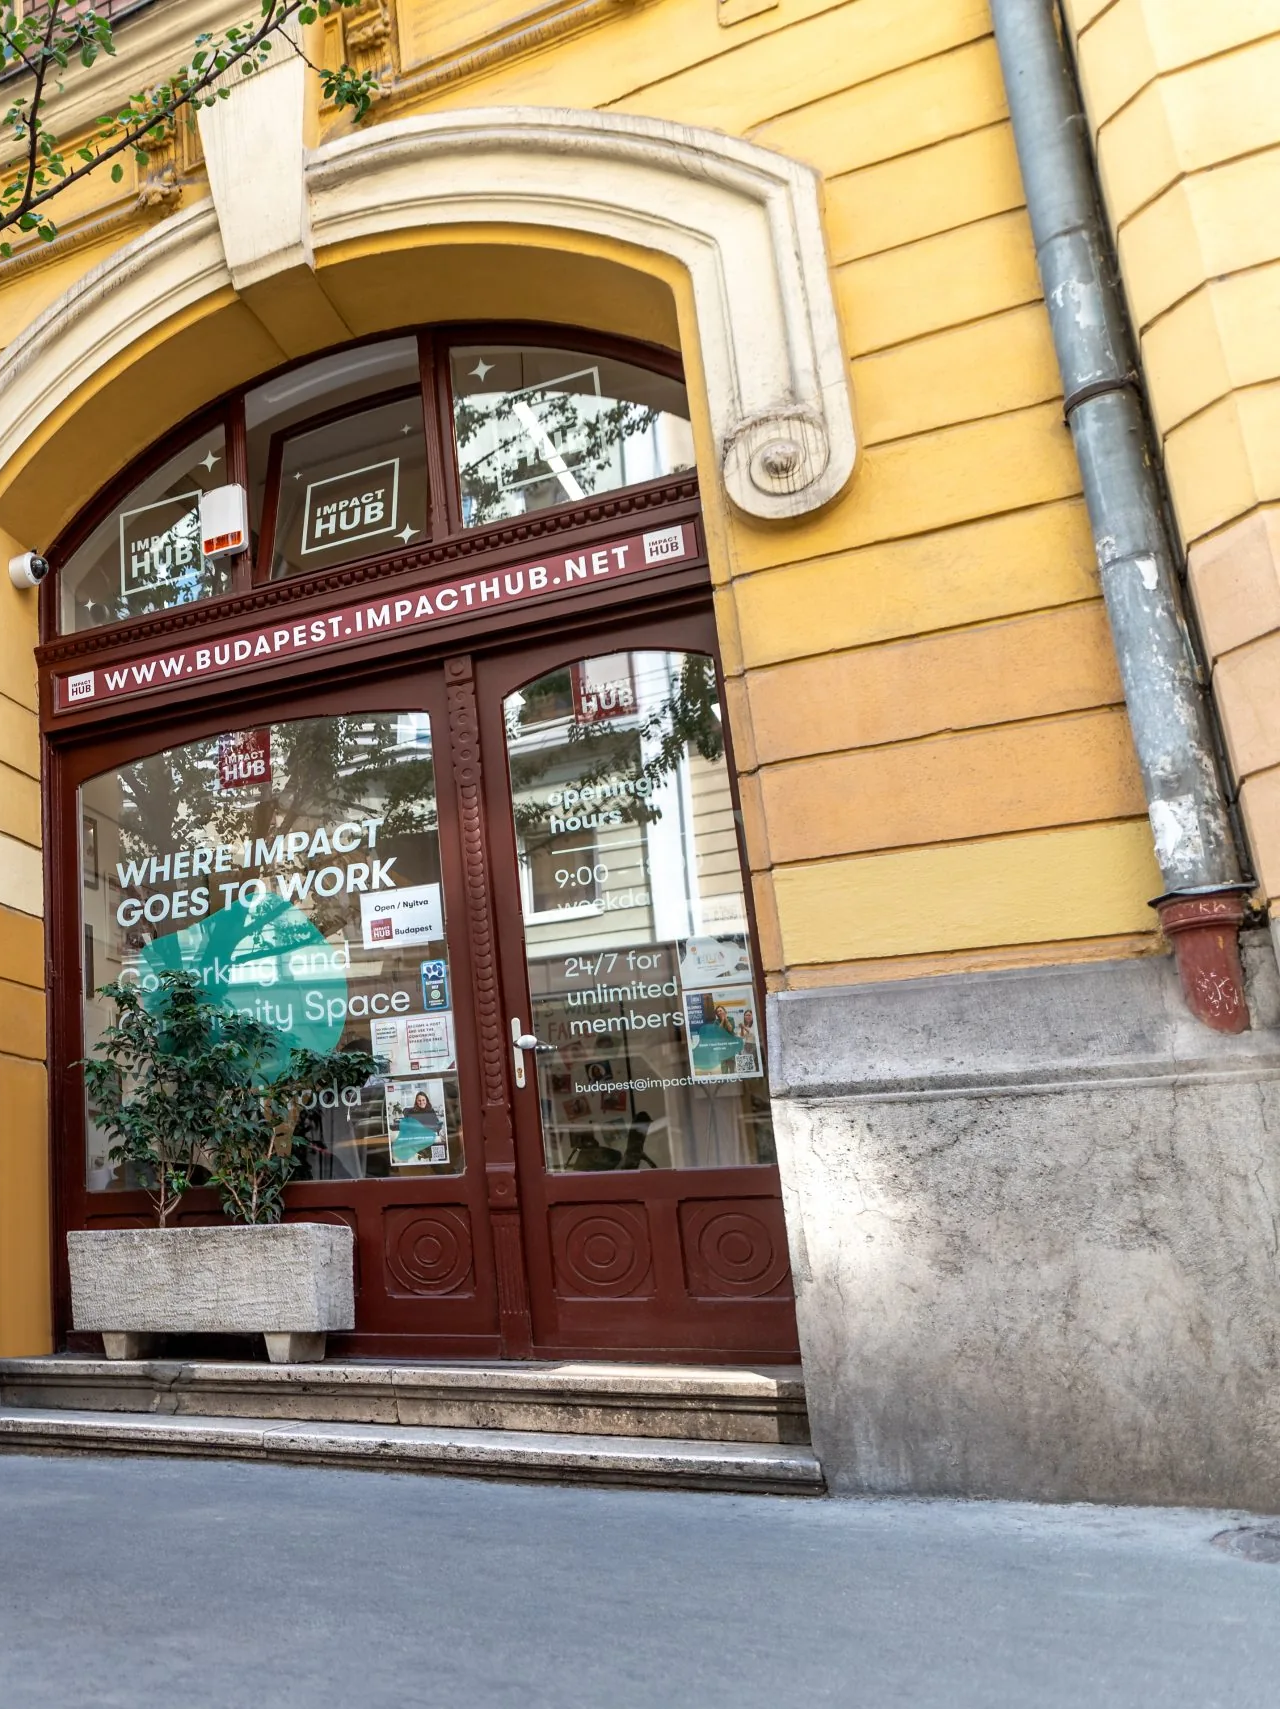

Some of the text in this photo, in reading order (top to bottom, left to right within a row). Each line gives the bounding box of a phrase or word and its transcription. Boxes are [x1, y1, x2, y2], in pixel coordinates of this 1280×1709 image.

[316, 488, 385, 517] IMPACT
[315, 501, 384, 539] HUB
[649, 536, 677, 546] IMPACT
[649, 542, 679, 556] HUB
[131, 545, 193, 579] HUB
[103, 544, 630, 691] WWW.BUDAPEST.IMPACTHUB.NET
[72, 685, 91, 696] HUB
[581, 687, 634, 713] HUB
[223, 760, 265, 780] HUB
[225, 750, 264, 765] IMPACT
[547, 776, 652, 810] opening
[550, 810, 623, 834] hours
[115, 817, 385, 889] WHERE IMPACT
[555, 863, 609, 889] 9:00
[116, 857, 398, 927] GOES TO WORK
[557, 888, 651, 911] weekda
[374, 903, 396, 912] Open
[402, 899, 429, 908] Nyitva
[373, 925, 433, 938] HUB Budapest
[118, 940, 351, 992] Coorking and
[564, 950, 662, 977] 24/7 for
[567, 976, 679, 1006] unlimited
[304, 990, 410, 1027] Space
[570, 1010, 685, 1035] members
